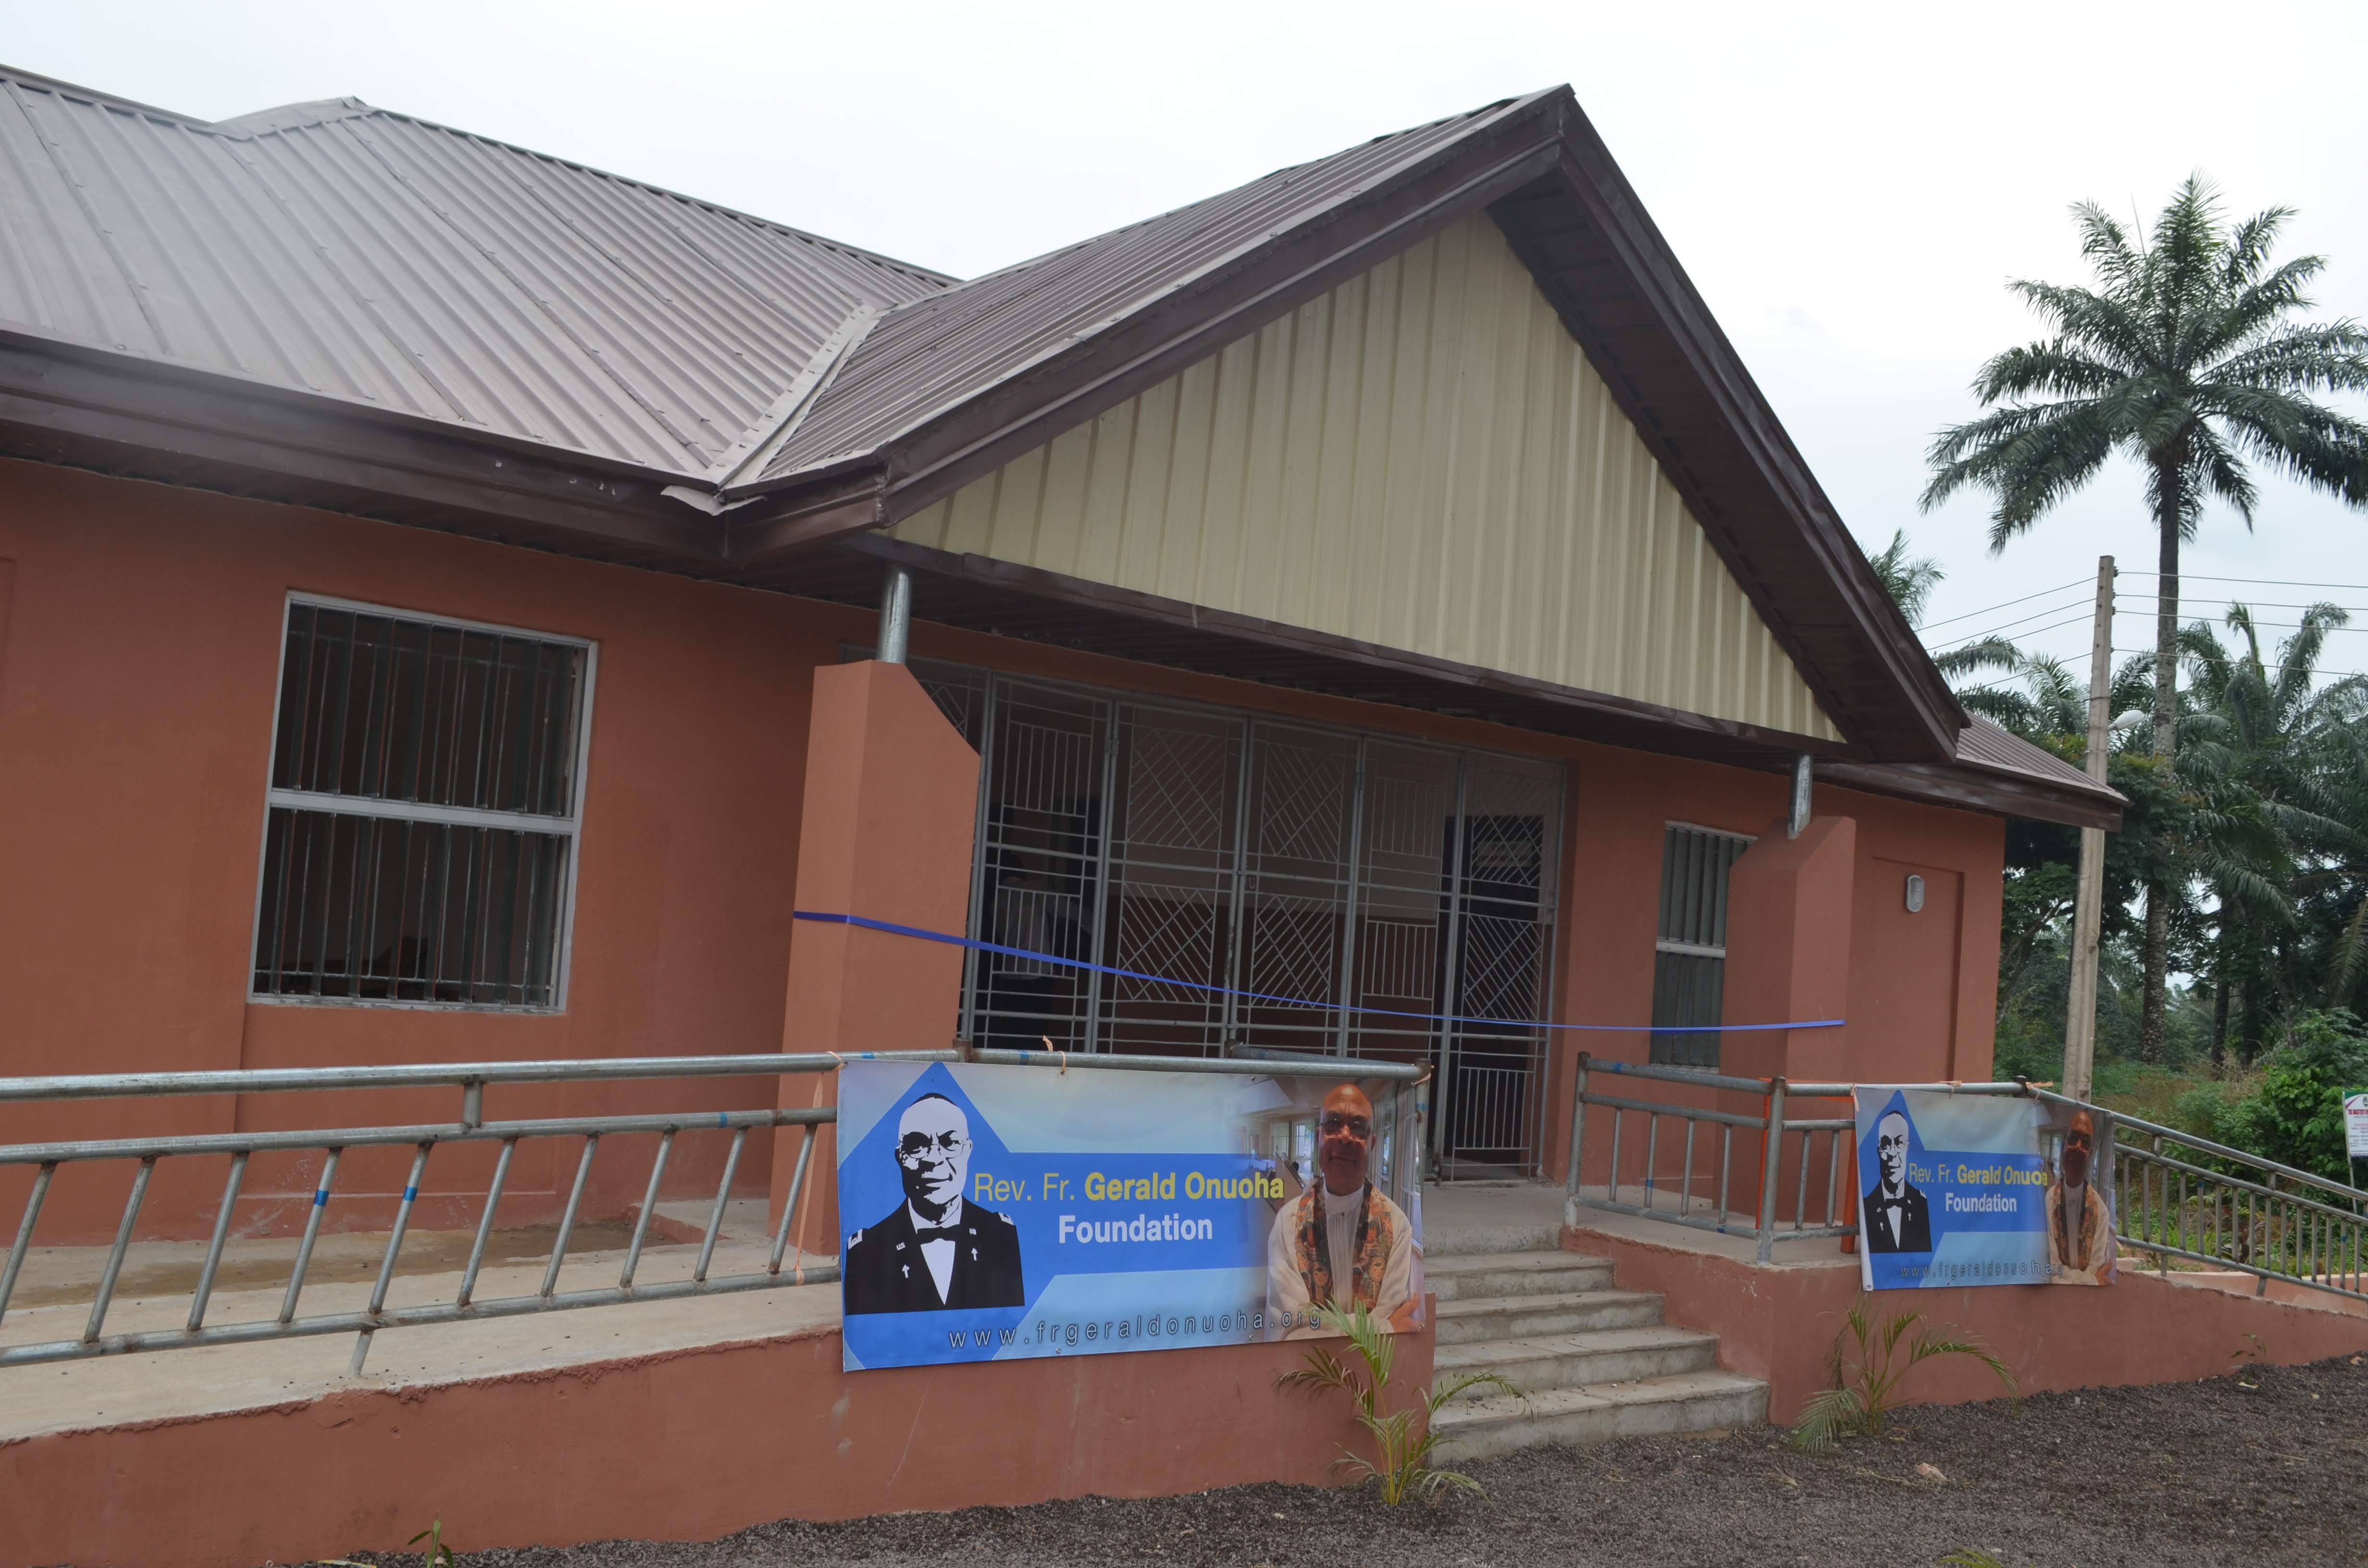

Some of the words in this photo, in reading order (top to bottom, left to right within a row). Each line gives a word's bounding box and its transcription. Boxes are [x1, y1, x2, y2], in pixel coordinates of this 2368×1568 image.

[974, 1173, 1032, 1201] Rev.
[1043, 1173, 1075, 1200] Fr.
[1084, 1172, 1176, 1201] Gerald
[1184, 1171, 1284, 1200] Onuoha
[1910, 1163, 1934, 1183] Rev.
[1938, 1164, 1954, 1183] Fr.
[1957, 1164, 2002, 1185] Gerald
[2004, 1165, 2048, 1187] Onuoa
[1946, 1192, 2017, 1213] Foundation
[1059, 1213, 1213, 1244] Foundation
[949, 1310, 1321, 1348] www.frgeraldonuoha.org
